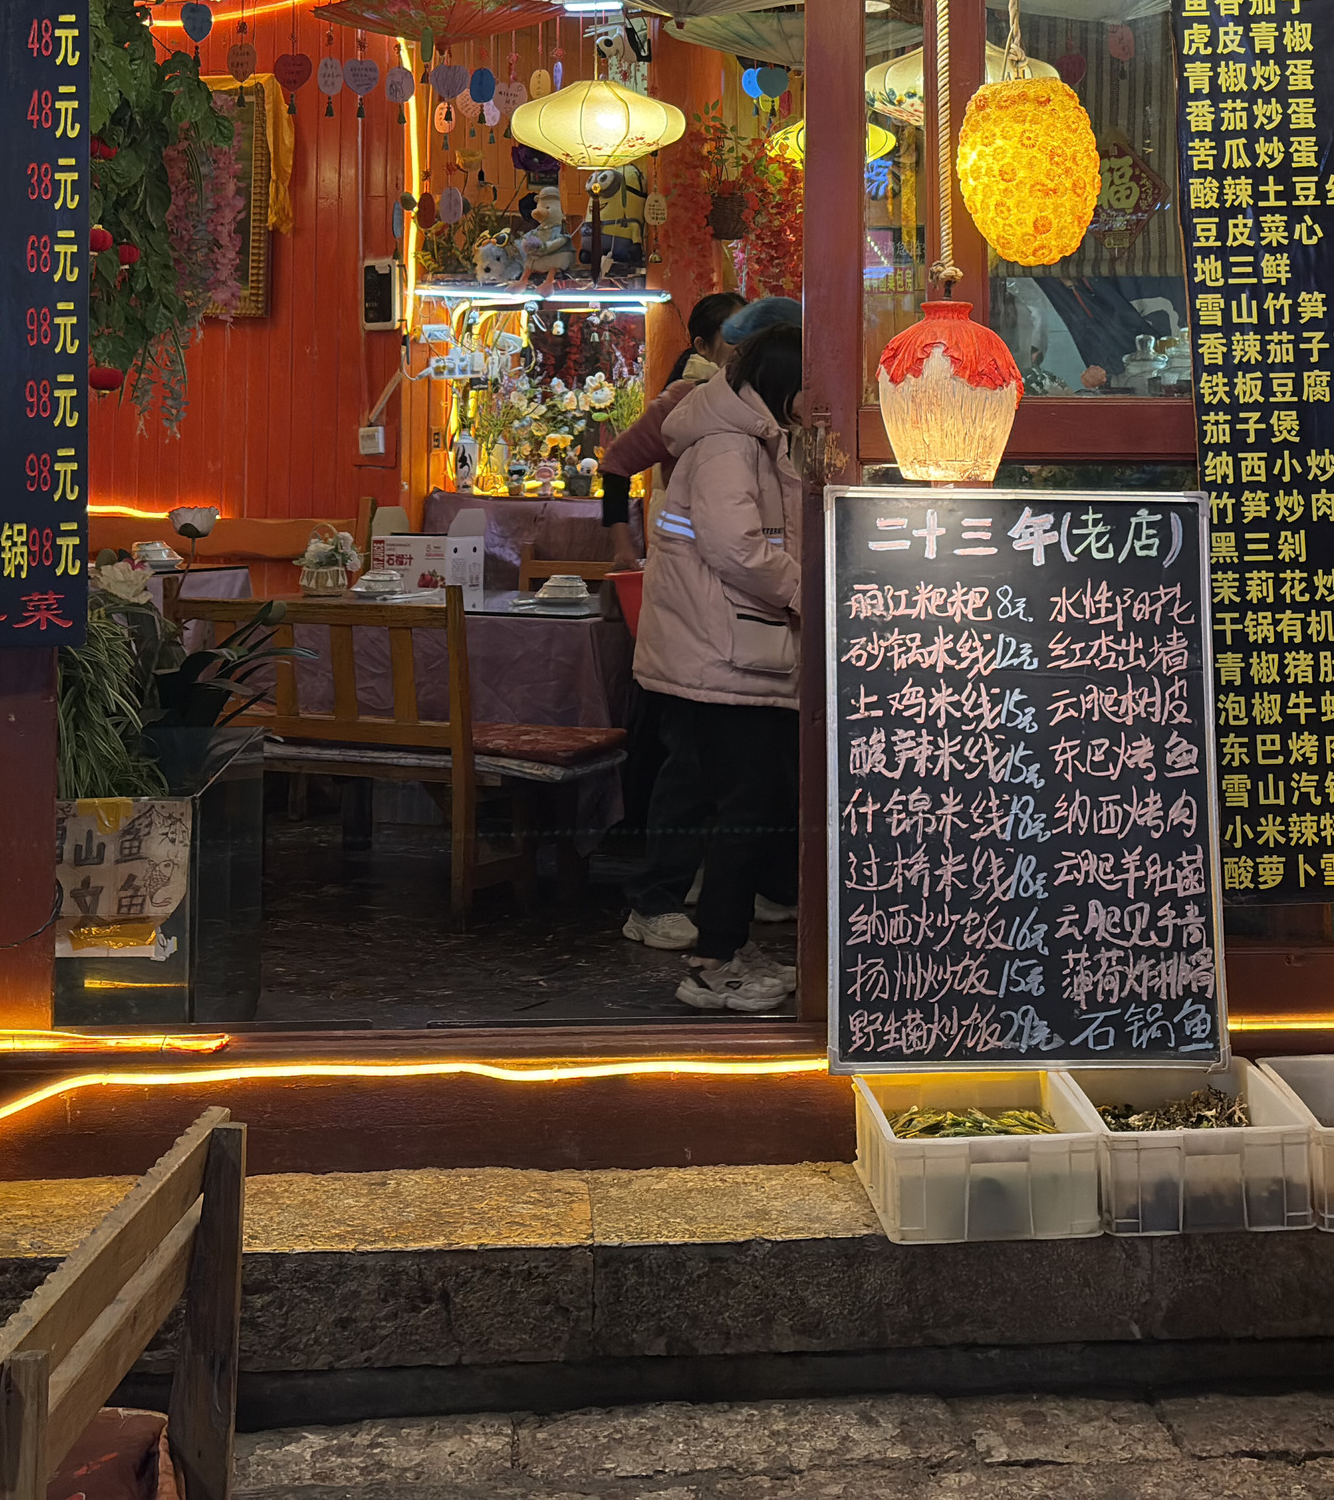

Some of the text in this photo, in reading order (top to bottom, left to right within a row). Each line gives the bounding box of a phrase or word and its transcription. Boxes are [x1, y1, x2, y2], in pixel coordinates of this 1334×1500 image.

[27, 14, 80, 66] 48元
[1182, 21, 1314, 56] 虎皮青椒
[1183, 59, 1315, 94] 青椒炒蛋
[27, 85, 80, 139] 48元
[1186, 97, 1317, 132] 番茄炒蛋
[1187, 136, 1319, 171] 苦瓜炒蛋
[27, 158, 80, 211] 38元
[26, 230, 79, 283] 68元
[1192, 213, 1324, 248] 豆皮菜心
[1193, 252, 1292, 287] 地三鲜
[26, 302, 80, 355] 98元
[1195, 291, 1327, 326] 雪山竹笋
[25, 374, 79, 428] 98元
[1199, 370, 1332, 405] 铁板豆腐
[1201, 410, 1301, 445] 茄子煲
[25, 447, 80, 502] 98元
[28, 522, 81, 578] 98元
[1210, 529, 1307, 564] 黑三剁
[844, 581, 991, 624] 丽江粑粑
[841, 625, 997, 679] 砂锅米线
[1047, 626, 1189, 671] 红杏出墙
[845, 677, 1004, 735] 土鸡米线
[849, 727, 1007, 784] 酸辣米线
[1049, 730, 1199, 782] 东巴烤鱼
[842, 786, 1012, 845] 什锦米线
[1052, 787, 1198, 839] 纳西烤肉
[844, 843, 1013, 904] 过桥米线
[846, 895, 1013, 952] 纳西炒饭
[845, 951, 999, 1003] 扬州炒饭
[847, 1002, 1004, 1057] 野生菌炒饭
[1070, 998, 1214, 1052] 石锅鱼
